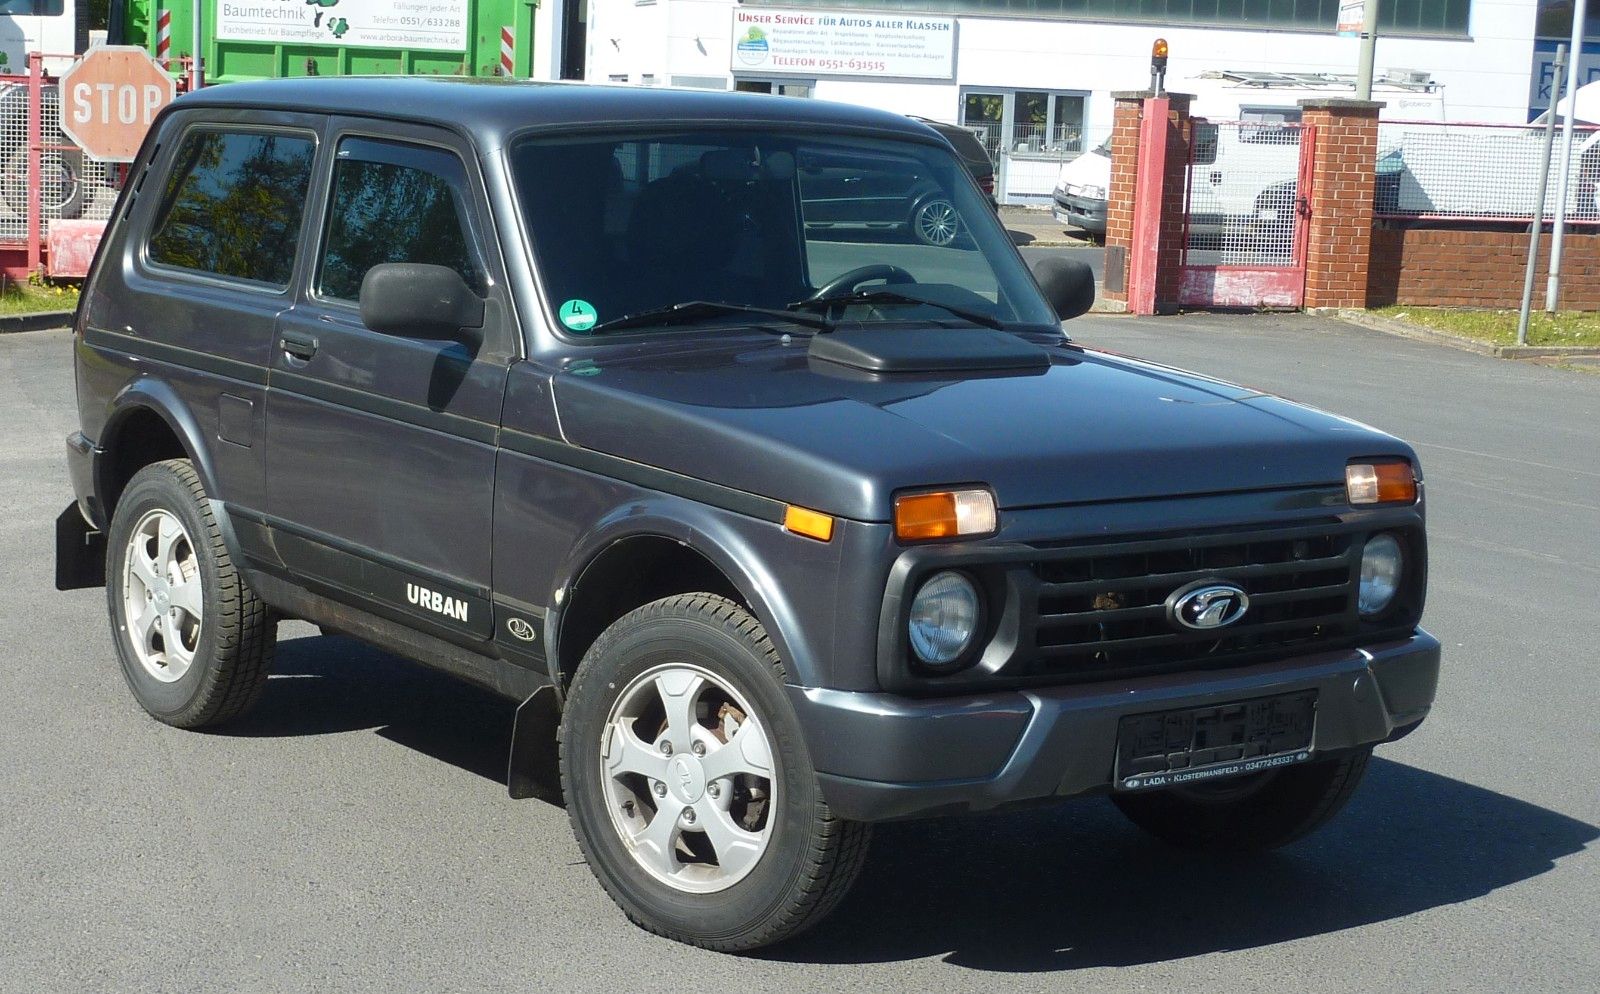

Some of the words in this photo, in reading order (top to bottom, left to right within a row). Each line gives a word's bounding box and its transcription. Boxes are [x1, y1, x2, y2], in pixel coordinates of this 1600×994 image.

[223, 4, 306, 19] Baumtechnik
[373, 16, 398, 24] Telefon
[906, 20, 949, 31] KLASSEN
[223, 25, 266, 35] Fachbetrieb
[268, 27, 278, 35] für
[281, 28, 325, 39] Baumpflege
[819, 58, 885, 71] 0551-631515
[73, 82, 163, 125] STOP
[572, 301, 583, 315] 4
[406, 583, 469, 622] URBAN
[1143, 777, 1166, 787] LADA
[1173, 766, 1239, 783] KLOSTERMANSFELD
